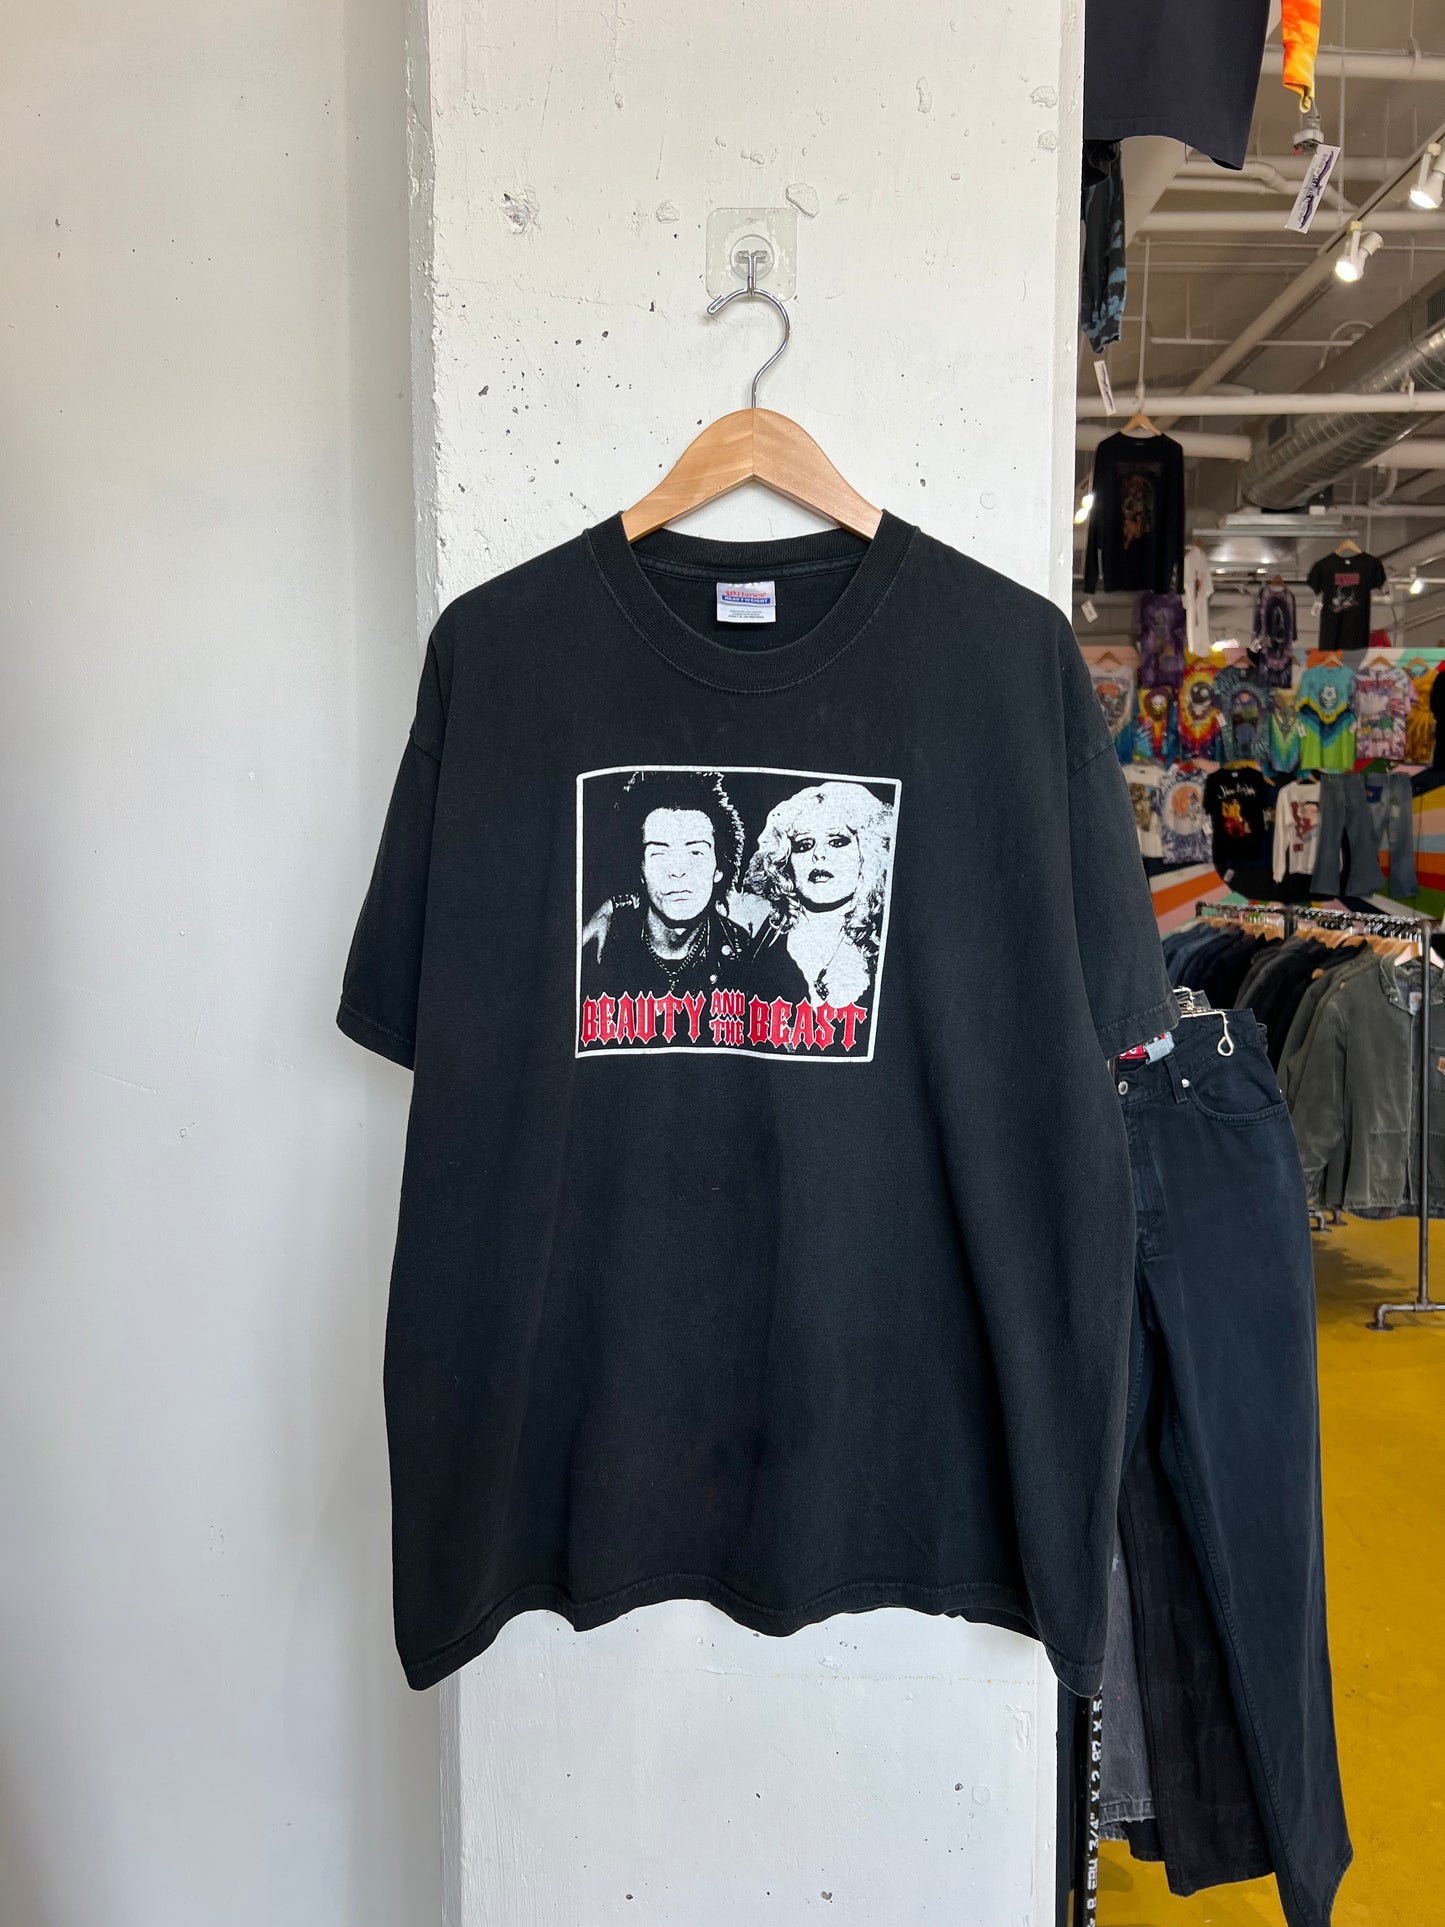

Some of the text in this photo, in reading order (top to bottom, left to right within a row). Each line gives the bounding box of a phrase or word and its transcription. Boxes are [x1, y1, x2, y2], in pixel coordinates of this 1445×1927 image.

[581, 988, 868, 1051] BEAUTY AND THE BEAST
